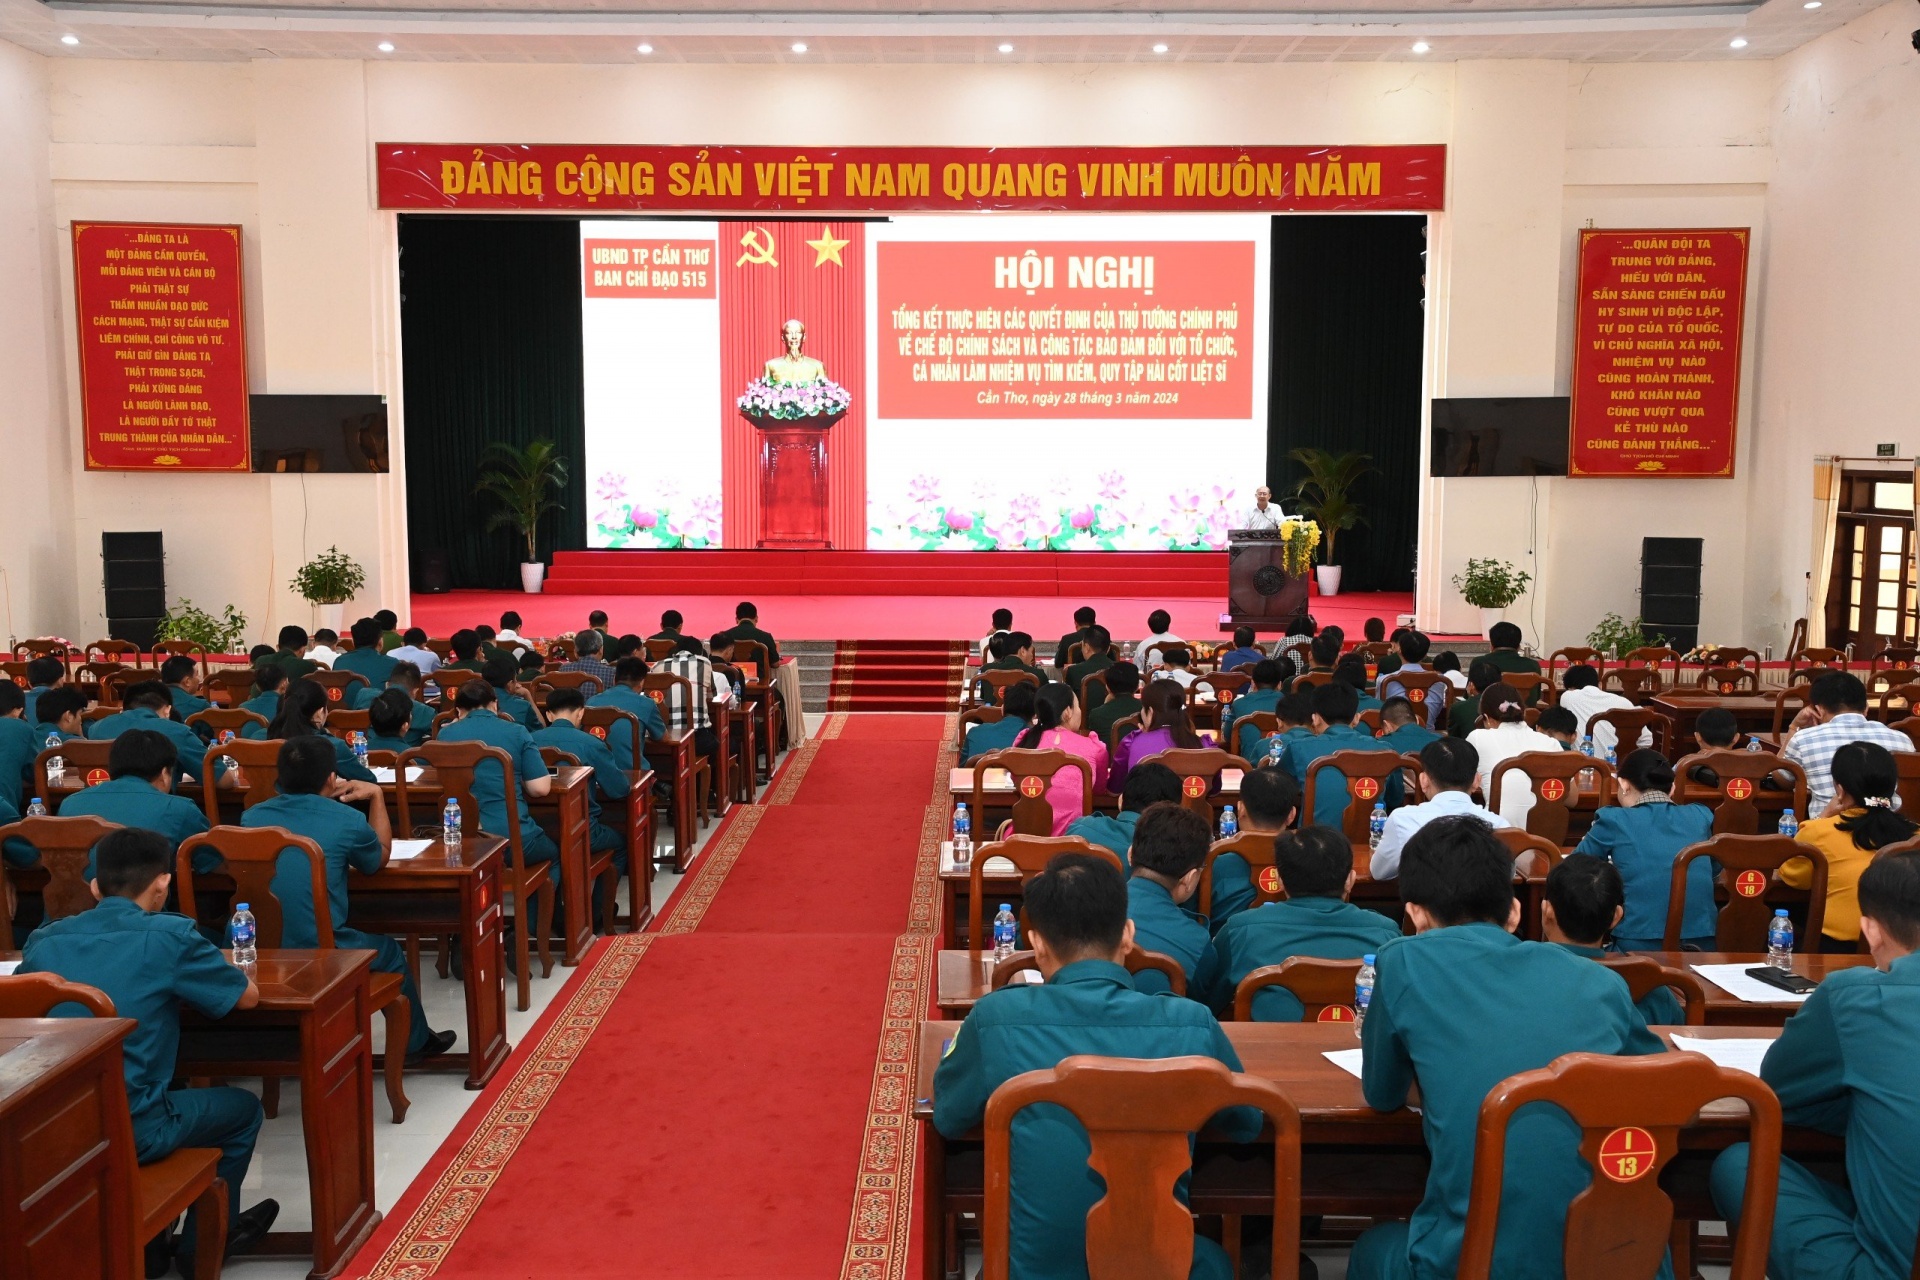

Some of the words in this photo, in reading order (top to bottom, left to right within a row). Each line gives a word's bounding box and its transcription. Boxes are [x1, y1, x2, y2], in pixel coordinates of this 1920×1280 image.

[442, 148, 542, 196] ĐẢNG
[556, 154, 654, 202] CỘNG
[668, 150, 742, 196] SẢN
[755, 156, 833, 202] VIỆT
[846, 162, 930, 197] NAM
[943, 162, 1067, 200] QUANG
[1078, 162, 1163, 197] VINH
[1174, 156, 1282, 197] MUÔN
[1295, 155, 1380, 196] NĂM
[1671, 237, 1692, 250] ĐỘI
[1697, 239, 1710, 248] TA
[592, 248, 628, 264] UBND
[632, 249, 648, 264] TP
[652, 246, 680, 264] CẦN
[684, 248, 710, 265] THƠ
[1611, 256, 1651, 265] TRUNG
[1655, 254, 1674, 265] VỚI
[995, 249, 1053, 295] HỘI
[1068, 256, 1153, 295] NGHỊ
[1621, 271, 1649, 282] HIẾU
[1654, 271, 1672, 282] VỚI
[594, 270, 621, 285] BAN
[626, 267, 647, 286] CHỈ
[652, 270, 678, 290] ĐẠO
[682, 271, 706, 287] 515
[1621, 289, 1654, 299] SÀNG
[1658, 288, 1696, 299] CHIẾN
[1700, 287, 1725, 299] ĐẤU
[1598, 307, 1614, 316] HY
[1618, 307, 1648, 316] SINH
[1652, 305, 1663, 316] VÌ
[1667, 305, 1692, 318] ĐỘC
[923, 304, 943, 329] KẾT
[945, 308, 972, 332] THỰC
[976, 306, 1000, 332] HIỆN
[1004, 306, 1025, 329] CÁC
[1029, 304, 1062, 330] QUYẾT
[1064, 310, 1090, 333] ĐỊNH
[1093, 302, 1115, 329] CỦA
[1118, 302, 1138, 329] THỦ
[1141, 305, 1176, 329] TƯỚNG
[1179, 306, 1212, 329] CHÍNH
[1216, 302, 1237, 329] PHỦ
[1598, 323, 1613, 334] TỰ
[1618, 324, 1634, 333] DO
[1638, 321, 1662, 332] CỦA
[898, 331, 911, 355] VỀ
[914, 331, 935, 355] CHẾ
[956, 334, 988, 355] CHÍNH
[992, 333, 1020, 355] SÁCH
[1023, 334, 1037, 355] VÀ
[1040, 333, 1069, 355] CÔNG
[1072, 334, 1092, 355] TÁC
[1096, 330, 1117, 355] BẢO
[1120, 330, 1145, 355] ĐẢM
[1169, 332, 1186, 355] VỚI
[1593, 339, 1604, 349] VÌ
[1608, 338, 1633, 349] CHỦ
[1637, 339, 1674, 349] NGHĨA
[1679, 339, 1695, 349] XÃ
[1613, 356, 1653, 368] NHIỆM
[1659, 357, 1673, 368] VỤ
[1681, 355, 1705, 366] NÀO
[149, 368, 176, 376] TRONG
[913, 359, 927, 381] CÁ
[963, 359, 986, 381] LÀM
[989, 359, 1024, 385] NHIỆM
[1027, 363, 1041, 385] VỤ
[1043, 359, 1063, 381] TÌM
[1099, 362, 1120, 383] QUY
[1123, 359, 1144, 385] TẬP
[1146, 359, 1164, 381] HÀI
[1167, 357, 1187, 381] CỐT
[1191, 359, 1213, 385] LIỆT
[1598, 373, 1630, 382] CŨNG
[1636, 372, 1668, 382] HOÀN
[977, 389, 999, 403] Cần
[1032, 391, 1061, 406] ngày
[1063, 392, 1076, 403] 28
[1080, 391, 1112, 406] tháng
[1115, 392, 1121, 403] 3
[1125, 391, 1150, 403] năm
[1153, 392, 1178, 403] 2024
[1611, 389, 1634, 399] KHÓ
[1639, 389, 1673, 399] KHĂN
[1676, 389, 1700, 399] NÀO
[1607, 406, 1639, 416] CŨNG
[1644, 406, 1675, 418] VƯỢT
[1681, 407, 1704, 416] QUA
[1614, 420, 1630, 432] KẺ
[1635, 422, 1658, 432] THÙ
[1662, 422, 1687, 432] NÀO
[99, 432, 127, 441] TRUNG
[1587, 438, 1619, 448] CŨNG
[1623, 438, 1655, 449] ĐÁNH
[1192, 777, 1196, 785] F
[1737, 779, 1741, 787] F
[1028, 788, 1037, 796] 14
[1190, 787, 1198, 796] 15
[1362, 789, 1370, 798] 16
[1548, 790, 1556, 798] 17
[1735, 790, 1743, 798] 18
[1747, 872, 1754, 881] G
[1267, 881, 1277, 892] 16
[1744, 885, 1754, 895] 18
[1332, 1008, 1340, 1019] H
[1617, 1158, 1636, 1177] 13
